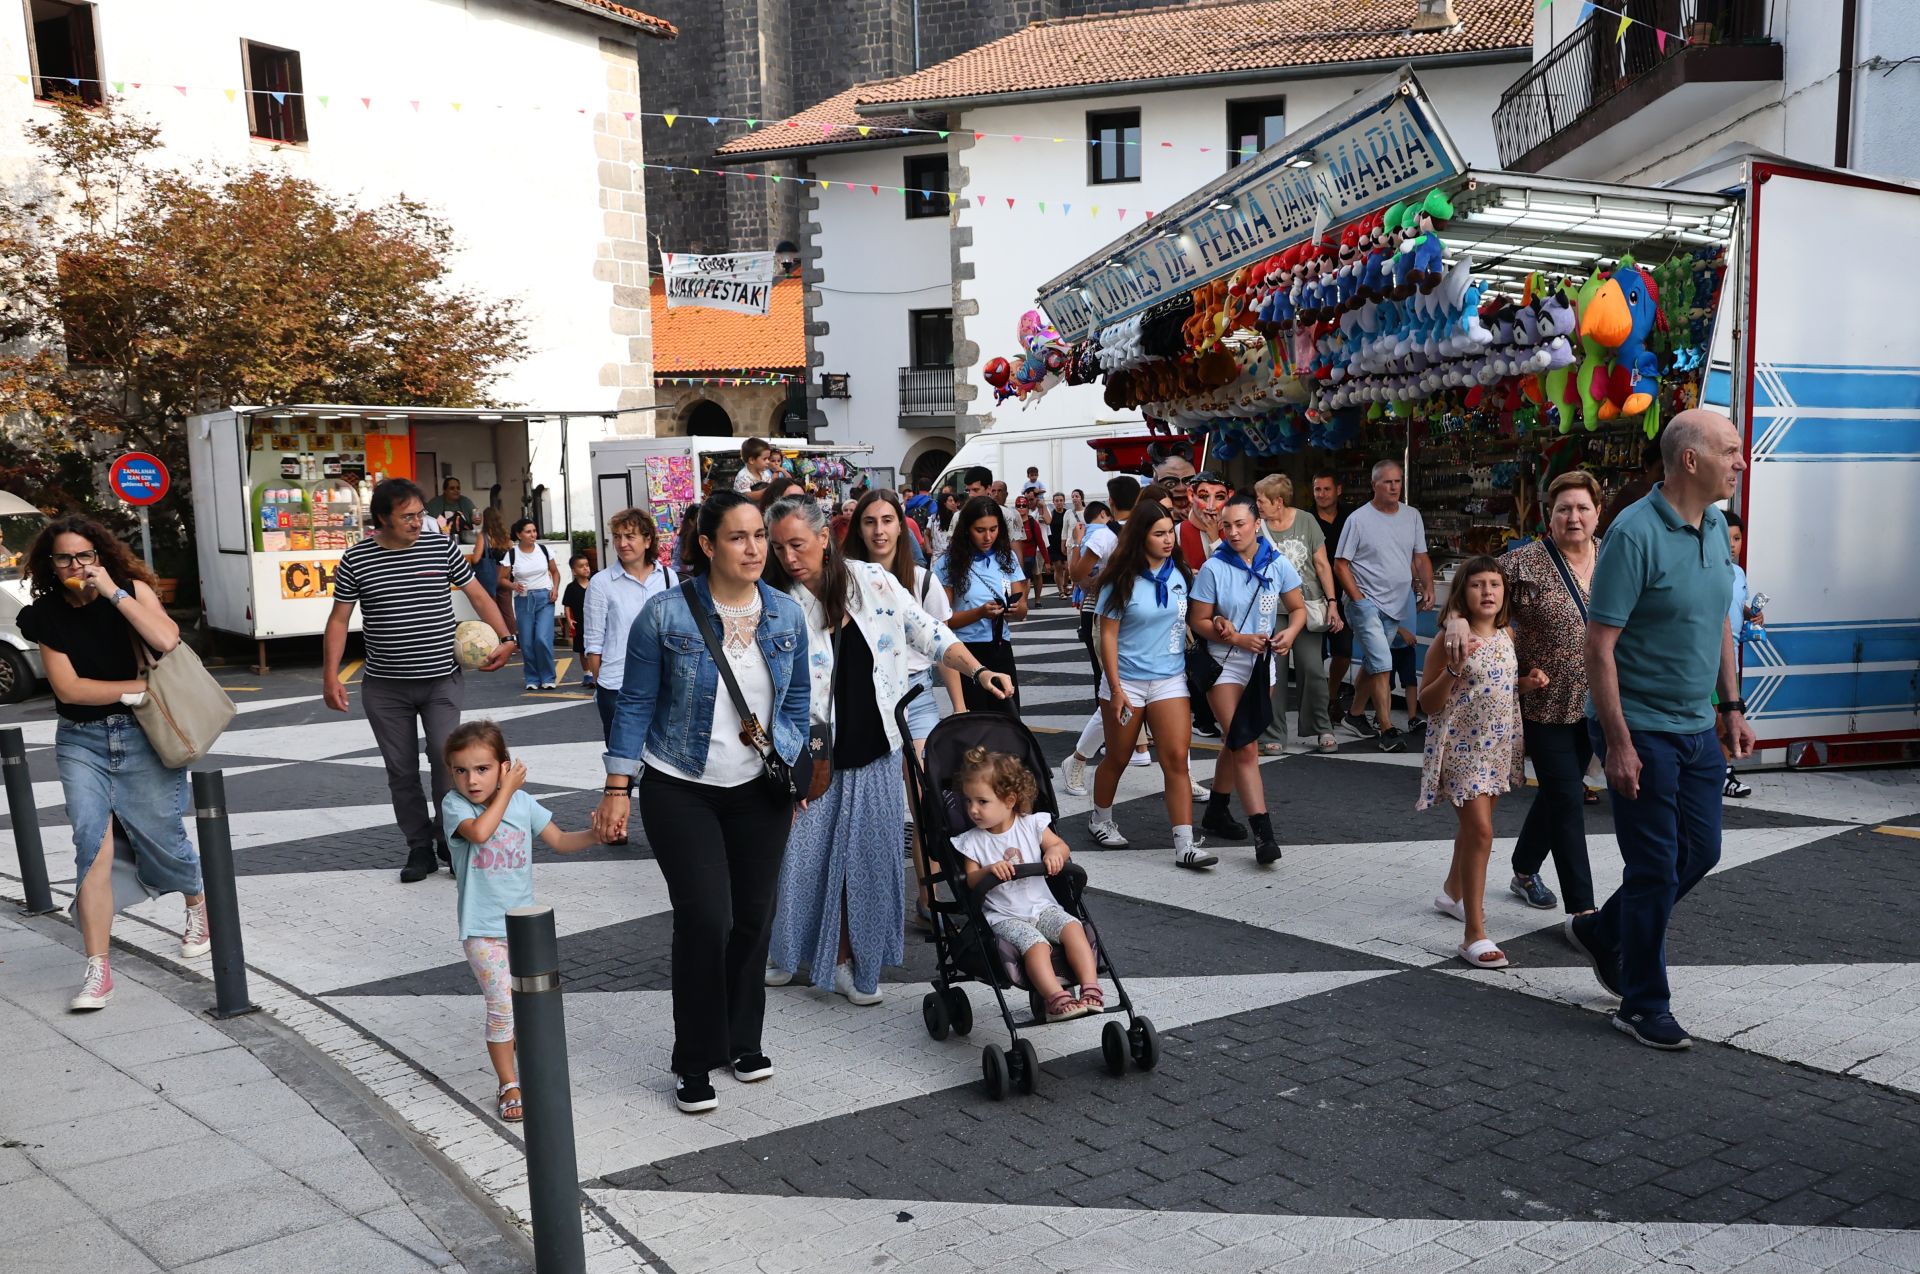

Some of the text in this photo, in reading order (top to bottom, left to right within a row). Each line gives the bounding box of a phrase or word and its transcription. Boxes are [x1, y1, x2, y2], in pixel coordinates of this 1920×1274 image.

[1323, 111, 1434, 208] MARIA
[1265, 168, 1320, 233] DANI
[1317, 171, 1332, 199] Y
[1190, 191, 1277, 268] FERIA
[1155, 235, 1196, 284] DE
[703, 278, 768, 314] FESTAK!
[476, 847, 527, 870] DAYS
